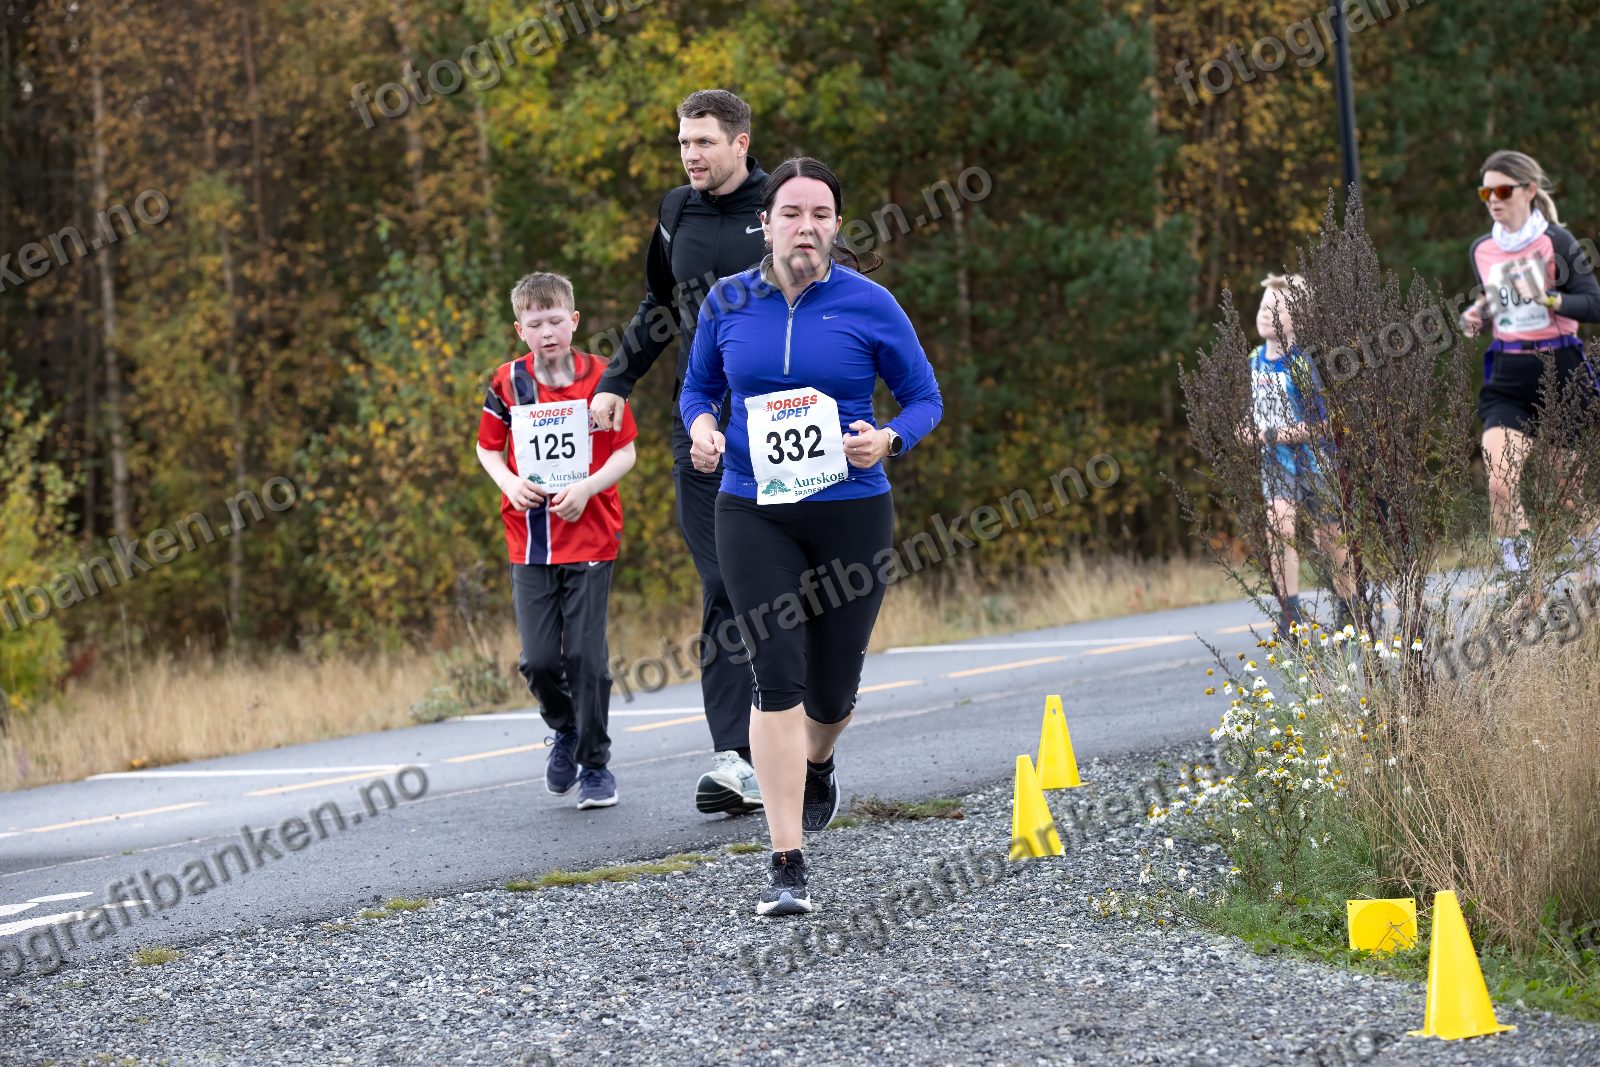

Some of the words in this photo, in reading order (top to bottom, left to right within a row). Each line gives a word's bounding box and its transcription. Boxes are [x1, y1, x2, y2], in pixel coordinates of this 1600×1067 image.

[765, 394, 818, 412] NORGES
[529, 407, 574, 419] NORGES
[771, 406, 810, 421] LØPET
[533, 416, 567, 427] LØPET
[529, 432, 576, 461] 125
[766, 424, 825, 465] 332
[549, 470, 587, 481] Aurskog
[794, 472, 845, 489] Aurskog
